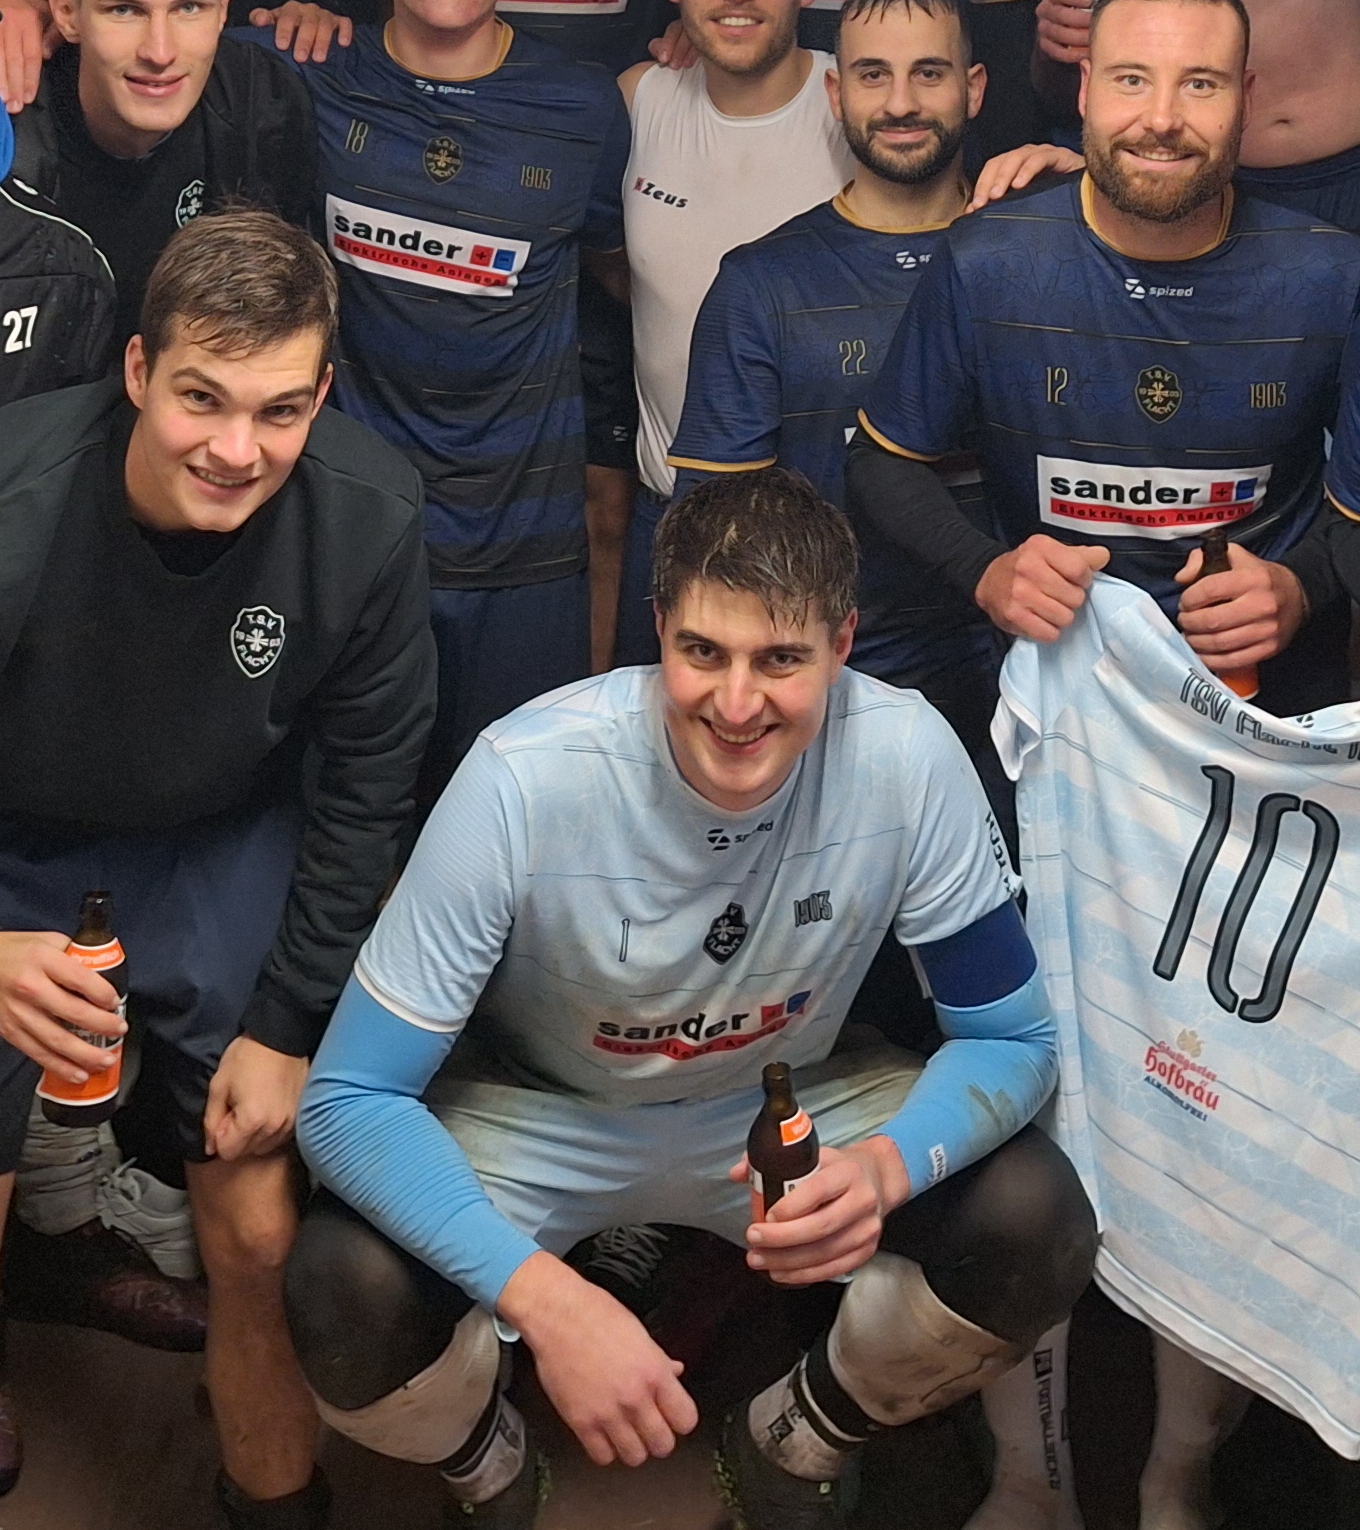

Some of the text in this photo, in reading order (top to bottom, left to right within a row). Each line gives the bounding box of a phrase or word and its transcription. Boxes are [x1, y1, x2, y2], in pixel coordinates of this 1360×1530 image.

[345, 119, 369, 154] 18
[520, 165, 553, 190] 1903
[641, 182, 688, 208] Zeus
[334, 214, 463, 259] sander
[339, 239, 502, 287] Elektrische Anlagen
[1149, 285, 1193, 298] spized
[3, 306, 38, 354] 27
[839, 339, 871, 376] 22
[1046, 366, 1068, 406] 12
[1250, 381, 1287, 409] 1903
[1050, 476, 1200, 505] sander
[1058, 504, 1245, 524] Elektrische Anlagen
[237, 644, 275, 667] FLACHT
[1180, 668, 1231, 724] TSV
[1152, 764, 1340, 1024] 10
[619, 918, 630, 962] 1
[598, 1012, 750, 1041] sander
